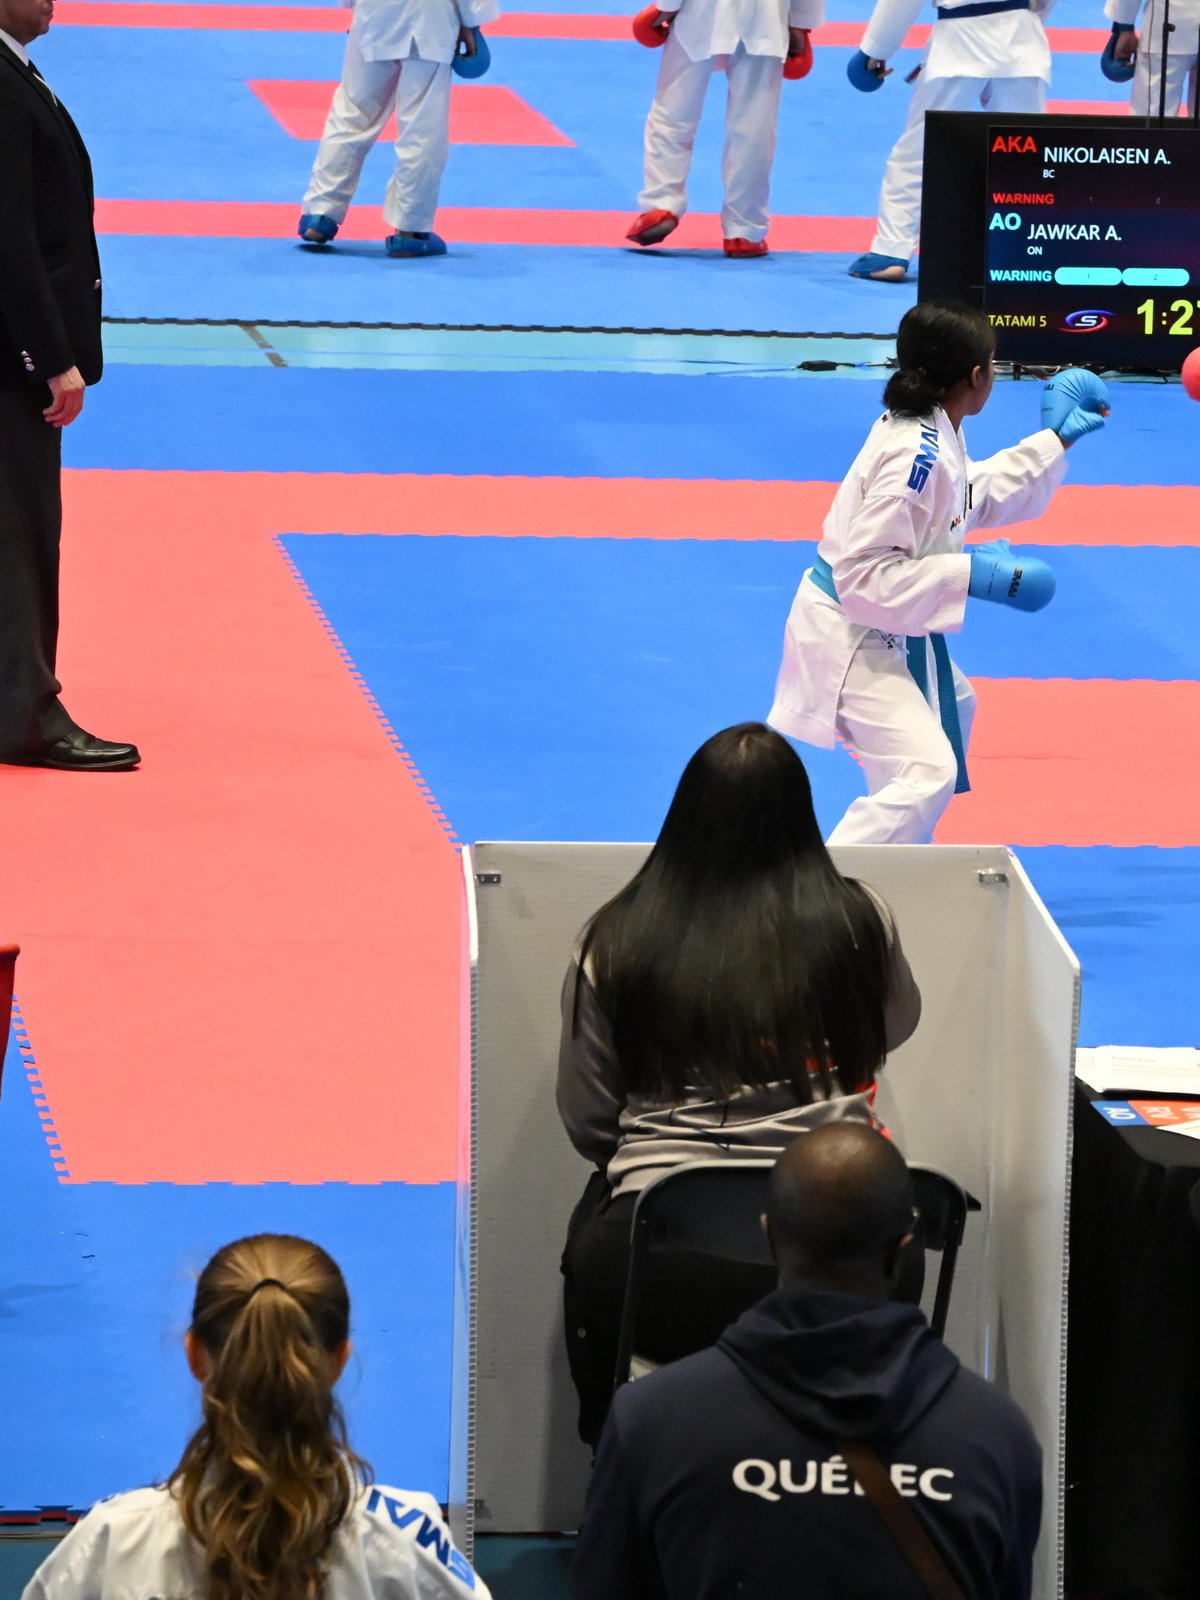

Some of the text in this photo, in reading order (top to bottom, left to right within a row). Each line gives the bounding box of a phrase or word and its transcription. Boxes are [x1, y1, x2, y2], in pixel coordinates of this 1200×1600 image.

[992, 136, 1037, 153] AKA
[1043, 147, 1172, 165] NIKOLAISEN A.
[1042, 169, 1056, 179] BC
[992, 193, 1055, 205] WARNING
[988, 213, 1022, 230] AO
[1026, 224, 1122, 241] JAWKAR A.
[1026, 246, 1043, 255] ON
[989, 270, 1052, 282] WARNING
[988, 315, 1047, 327] TATAMI 5
[732, 1454, 955, 1502] QUÉEC
[366, 1487, 476, 1592] SMAI
